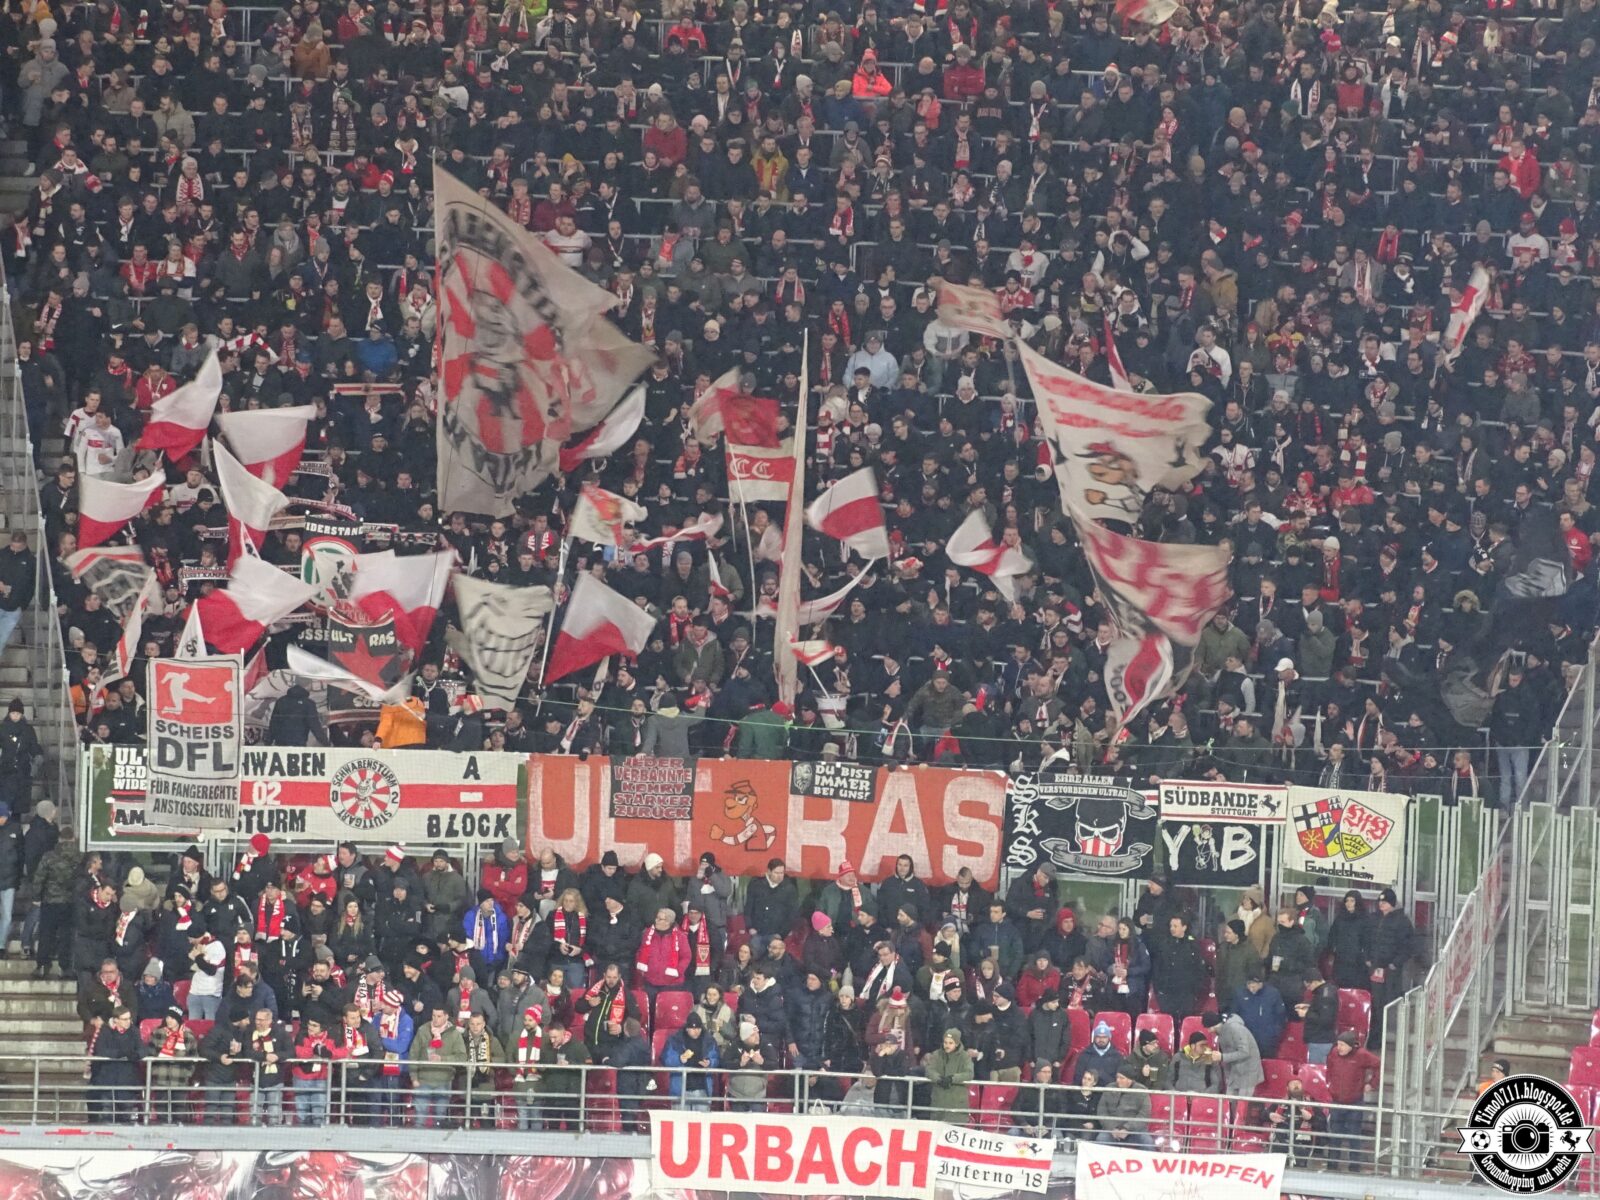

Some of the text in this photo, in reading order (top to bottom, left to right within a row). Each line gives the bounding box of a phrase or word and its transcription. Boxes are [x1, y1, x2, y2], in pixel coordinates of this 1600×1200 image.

[155, 719, 235, 740] SCHEISS
[157, 737, 234, 772] DFL
[623, 755, 684, 768] JEDER
[332, 759, 398, 788] SCHWABENSTURM
[462, 755, 481, 780] A
[614, 765, 693, 782] VERBANNTE
[815, 764, 872, 779] DU BIST
[150, 777, 238, 801] FÜR FANGERECHTE
[814, 774, 871, 791] IMMER
[1054, 773, 1114, 786] EHRE ALLEN
[252, 781, 282, 806] 02
[813, 786, 871, 801] BEI UNS!
[1038, 785, 1129, 798] VERSTORBENEN ULTRAS
[1164, 786, 1259, 809] SÜDBANDE
[153, 798, 235, 819] ANSTOSSZEITEN!
[337, 808, 393, 829] STUTTGART
[1210, 808, 1258, 817] STUTTGART
[427, 812, 512, 838] BLOCK
[1072, 854, 1125, 869] Kompanie
[944, 1129, 1005, 1153] Glems
[659, 1119, 933, 1189] URBACH
[936, 1160, 1014, 1185] Inferno
[1088, 1158, 1275, 1190] BAD WIMPFEN
